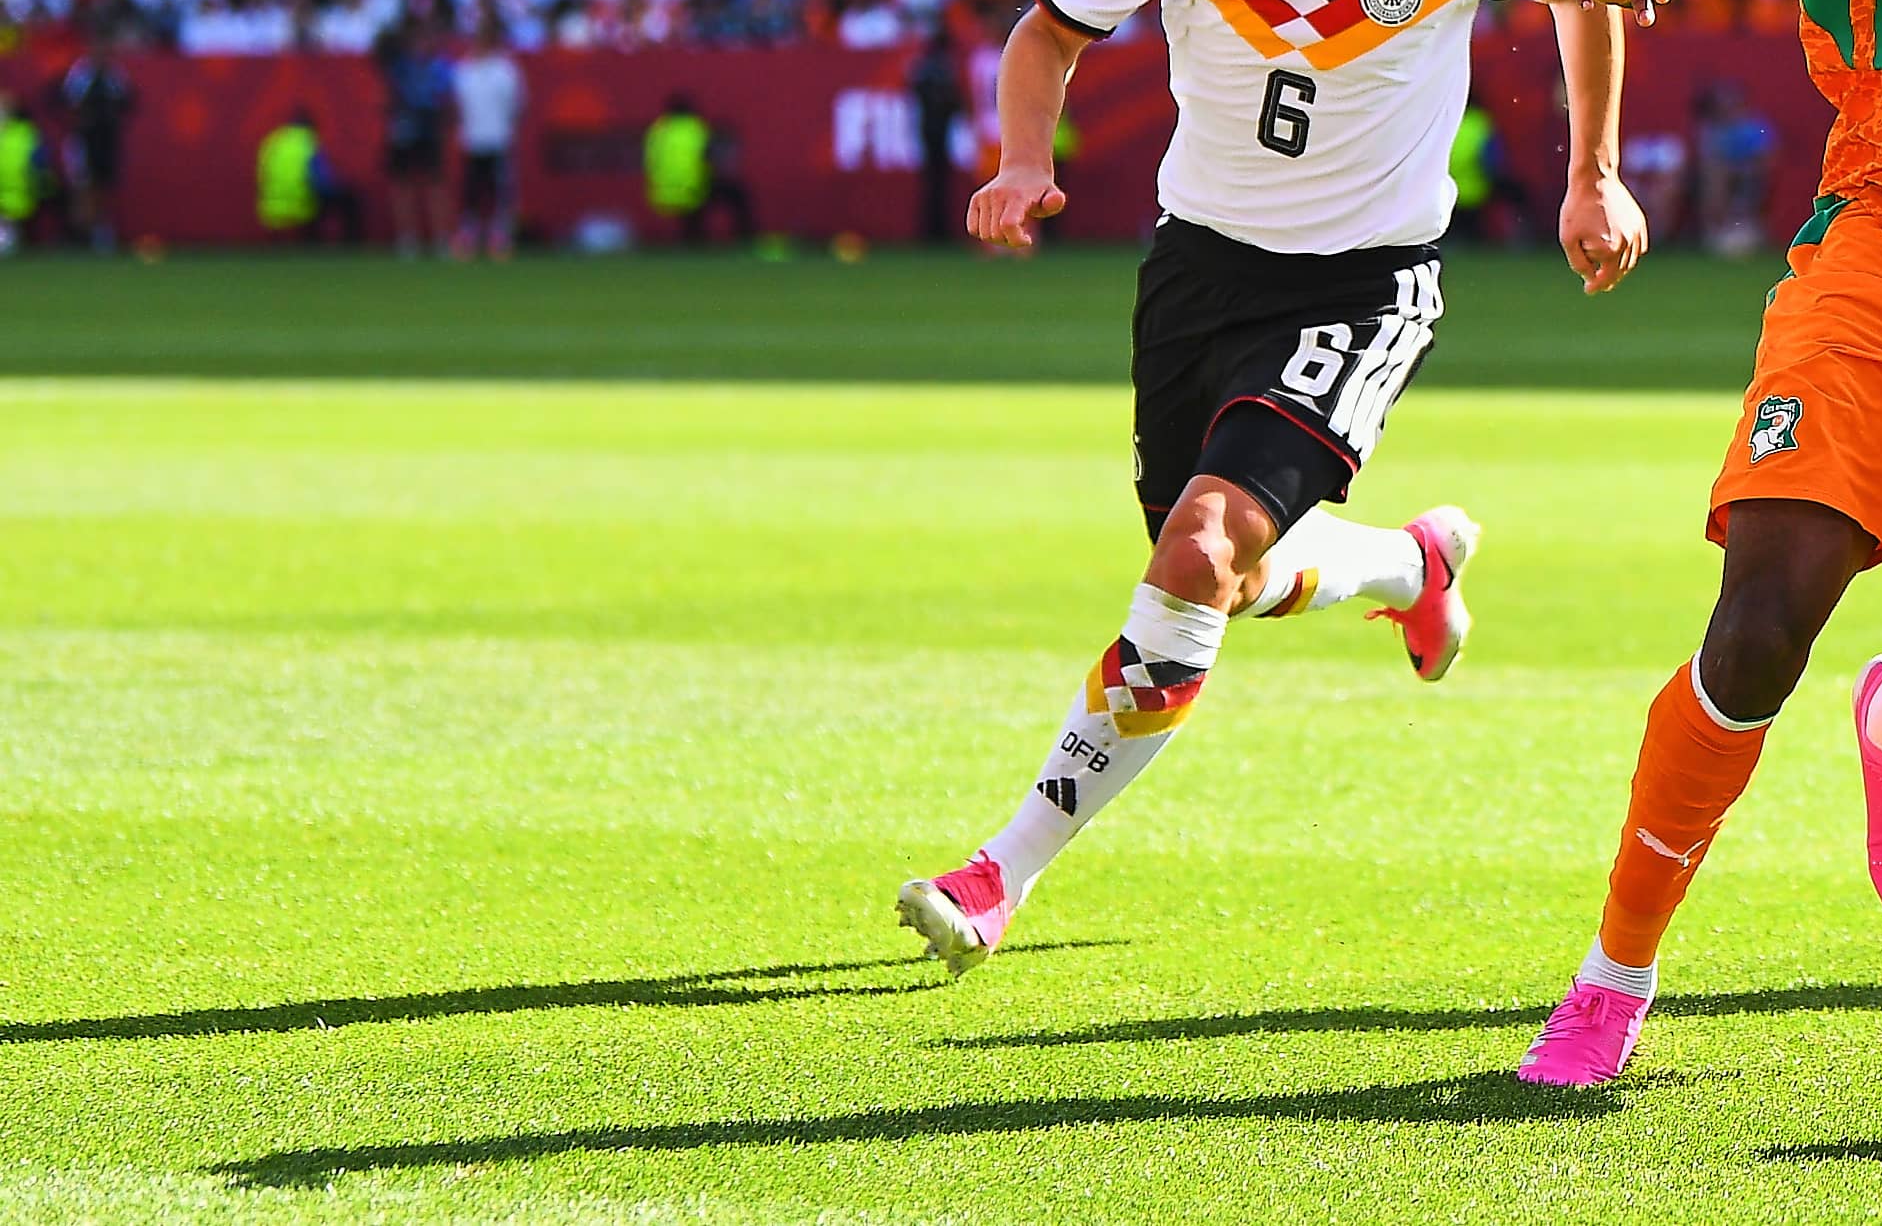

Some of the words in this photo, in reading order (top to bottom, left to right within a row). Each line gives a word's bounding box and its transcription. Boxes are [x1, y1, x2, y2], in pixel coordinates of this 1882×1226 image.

[1256, 68, 1317, 159] 6
[1281, 322, 1354, 396] 6
[1060, 730, 1111, 773] DFB
